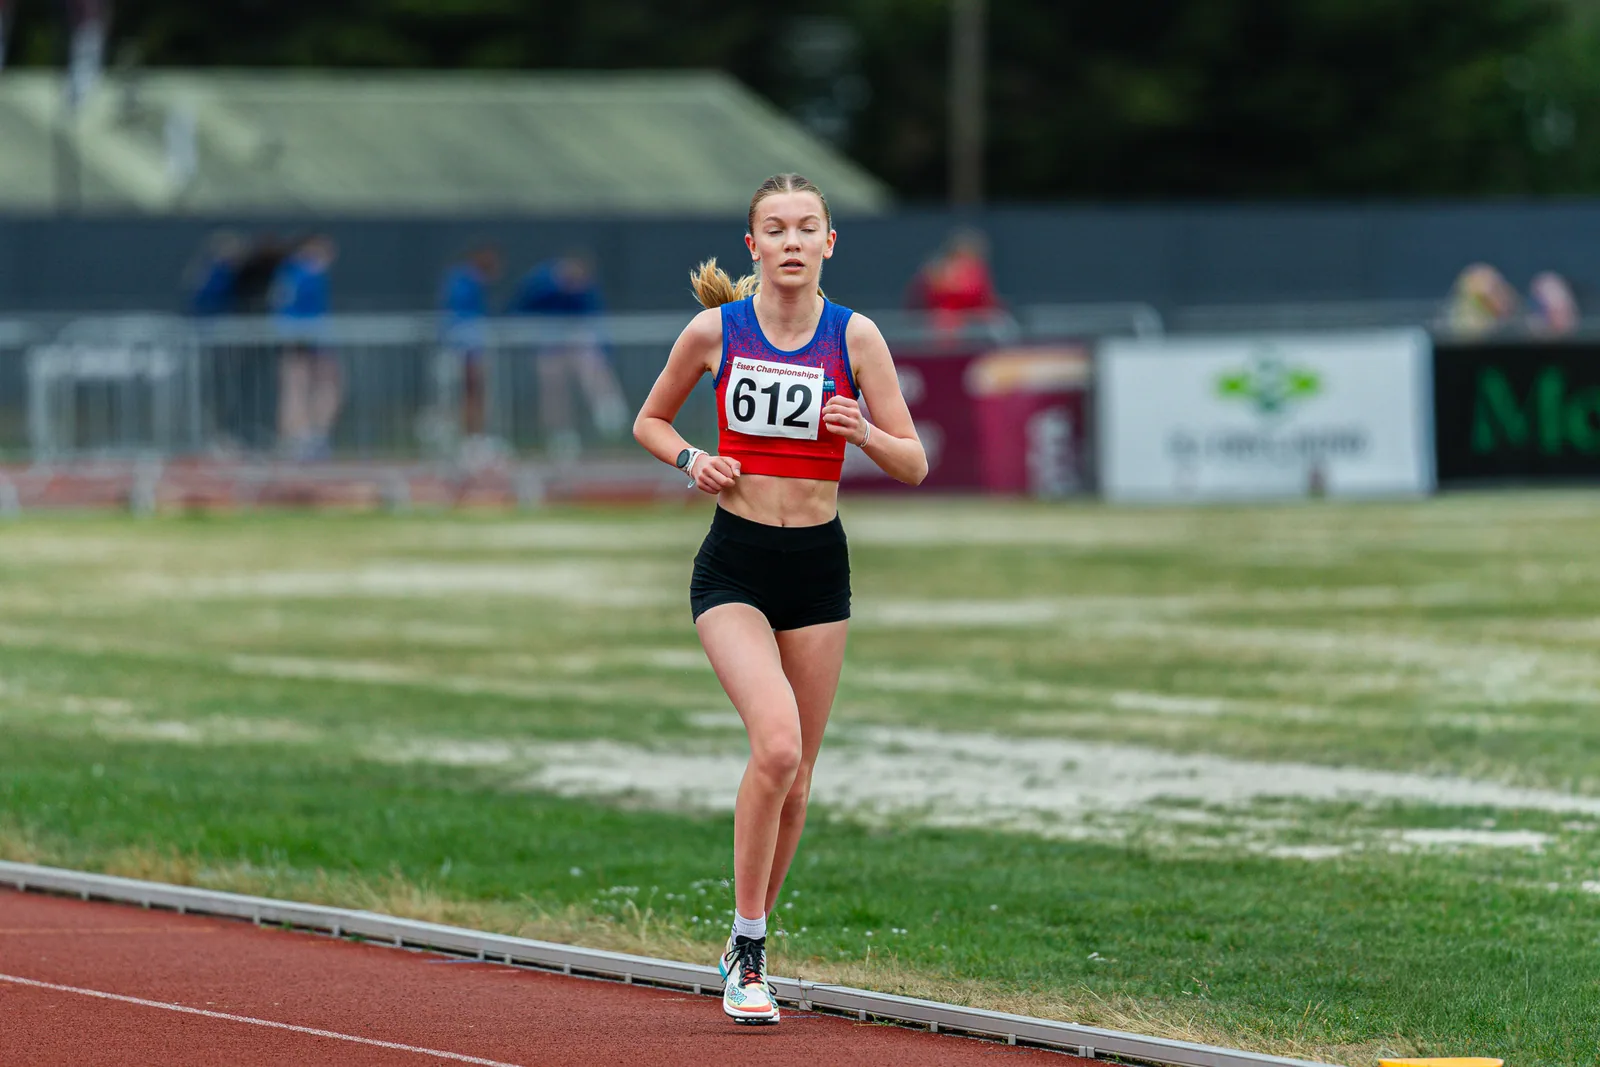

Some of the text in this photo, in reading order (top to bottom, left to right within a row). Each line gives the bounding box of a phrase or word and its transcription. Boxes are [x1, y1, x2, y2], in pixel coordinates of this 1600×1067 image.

[736, 361, 819, 379] Essex Championships
[733, 377, 812, 428] 612
